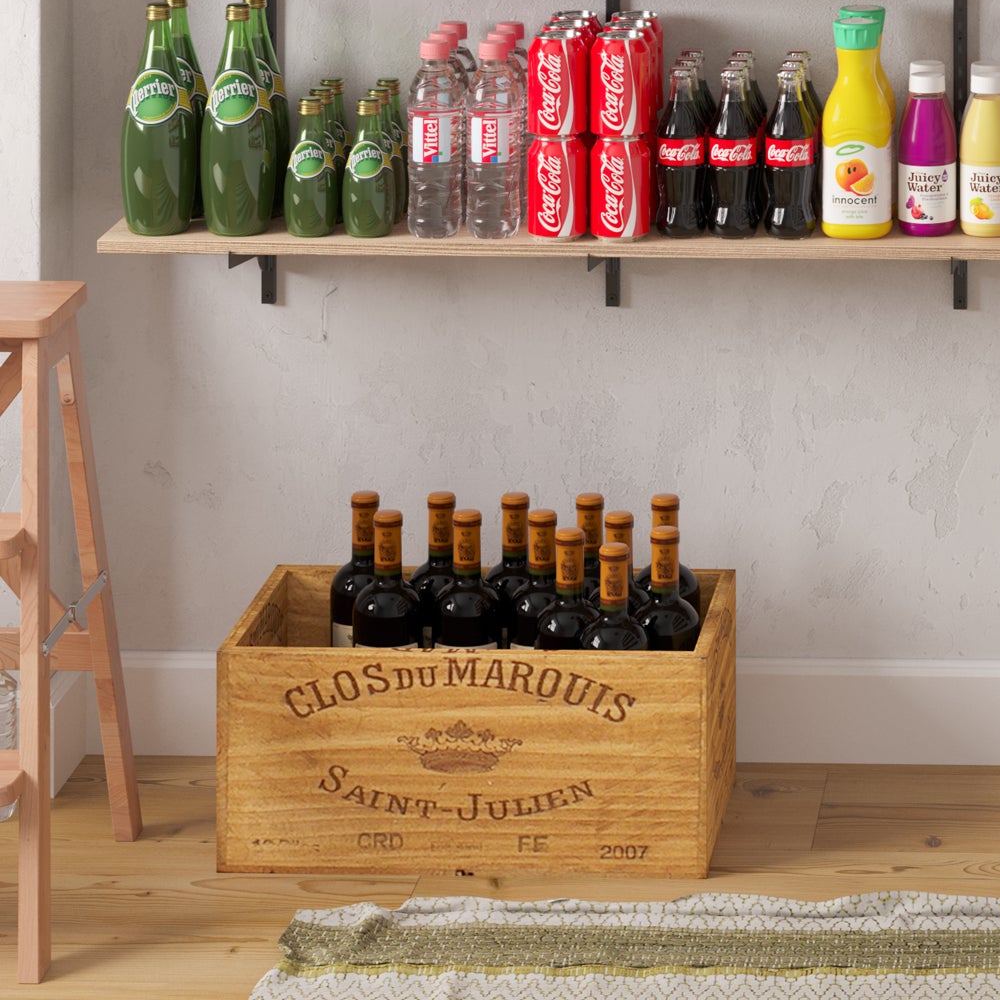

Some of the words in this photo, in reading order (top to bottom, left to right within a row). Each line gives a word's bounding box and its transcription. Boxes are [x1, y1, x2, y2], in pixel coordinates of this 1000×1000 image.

[537, 49, 562, 131] Coca-Cola
[600, 49, 625, 131] Coca-Cola
[424, 119, 439, 158] Vittel
[482, 119, 497, 158] Vittel
[659, 143, 701, 162] Coca-Cola
[711, 144, 752, 162] Coca-Cola
[767, 144, 809, 162] Coca-Cola
[537, 151, 562, 233] Coca-Cola
[600, 151, 625, 233] Coca-Cola
[908, 172, 941, 185] Juicy
[908, 182, 942, 193] Water
[832, 195, 877, 205] innocent
[284, 663, 391, 719] CLOS
[393, 666, 439, 690] DU
[443, 656, 636, 723] MARQUIS
[357, 832, 404, 851] CRD
[517, 835, 549, 853] FE
[601, 844, 649, 860] 2007
